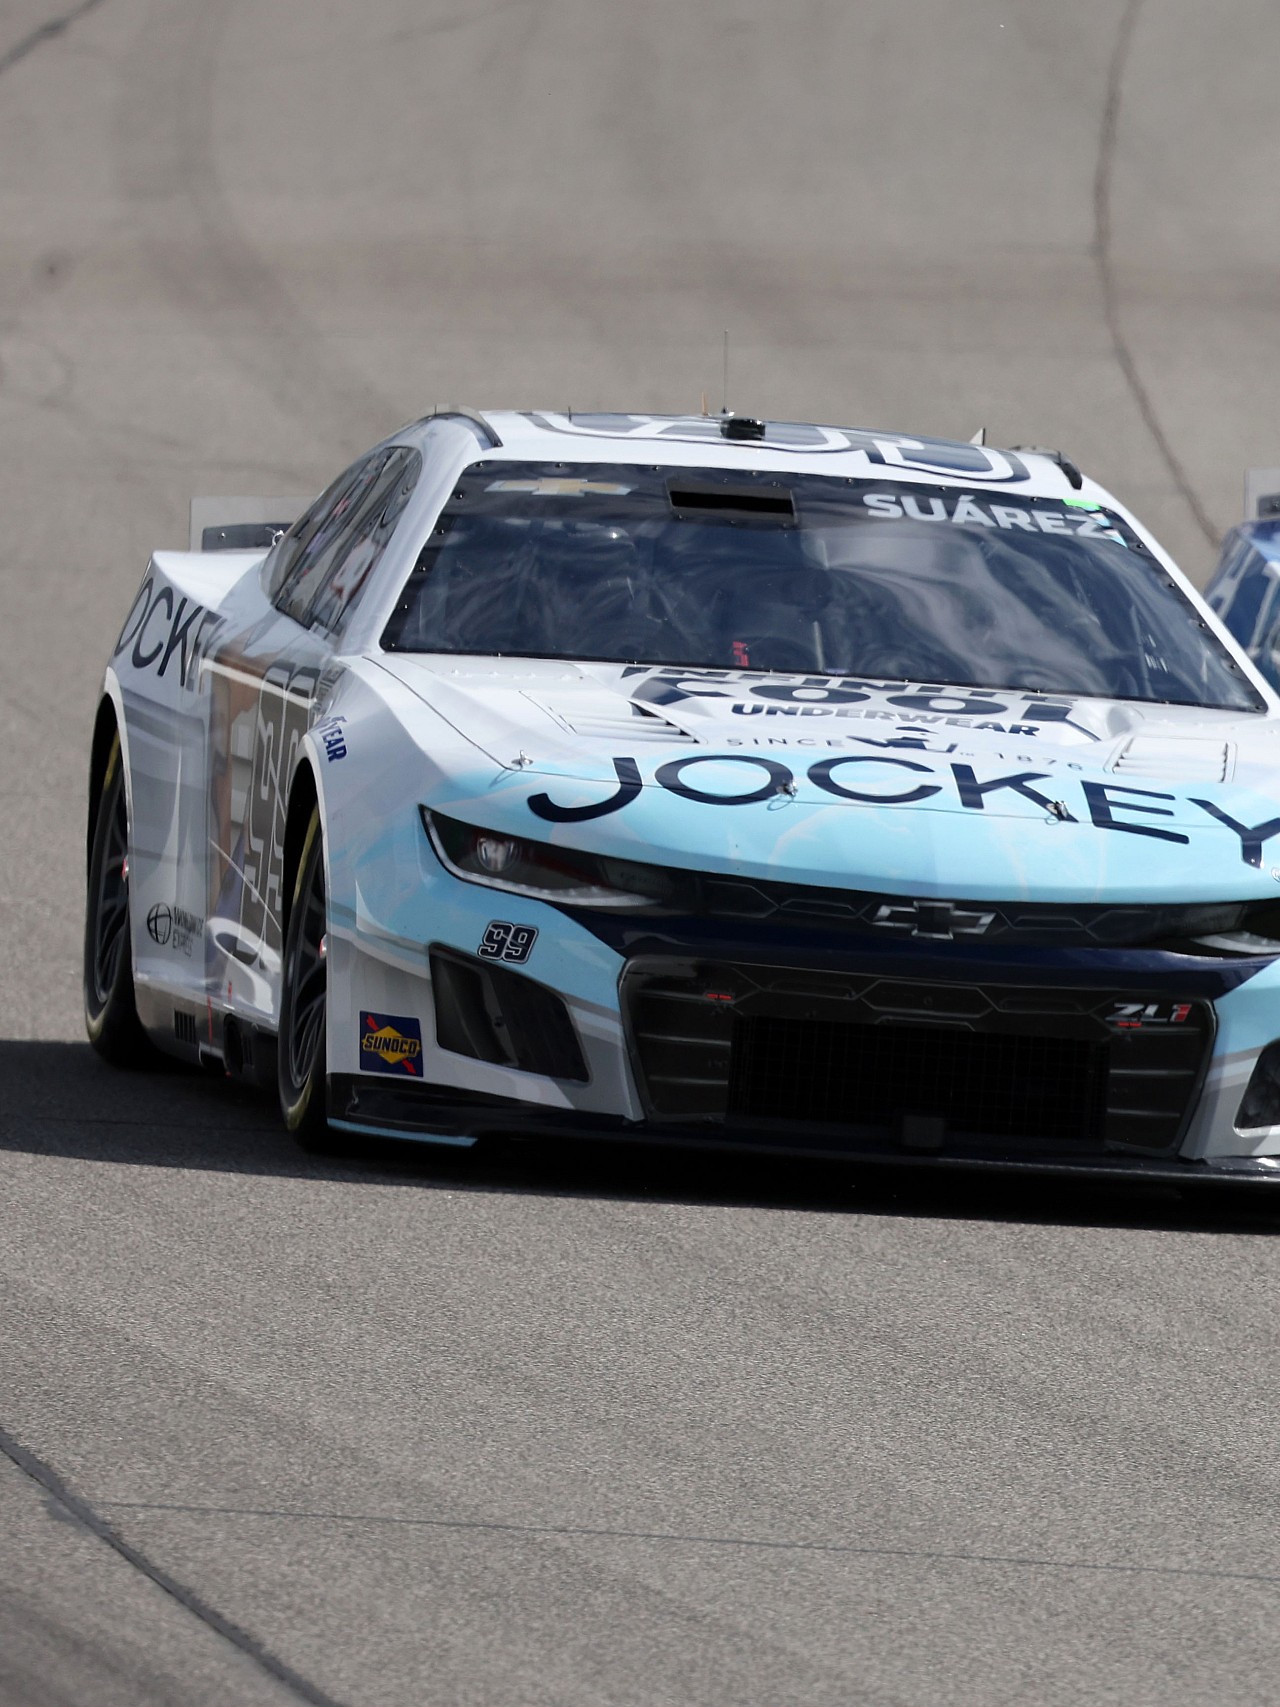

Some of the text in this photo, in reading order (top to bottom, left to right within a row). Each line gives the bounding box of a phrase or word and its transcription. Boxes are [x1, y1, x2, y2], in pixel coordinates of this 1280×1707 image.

[863, 492, 1104, 537] SUÁREZ
[731, 703, 1040, 738] UNDERWEAR
[727, 737, 846, 748] SINCE
[477, 920, 539, 964] 99
[1105, 1003, 1192, 1023] ZL1
[363, 1033, 421, 1057] SUNOCO
